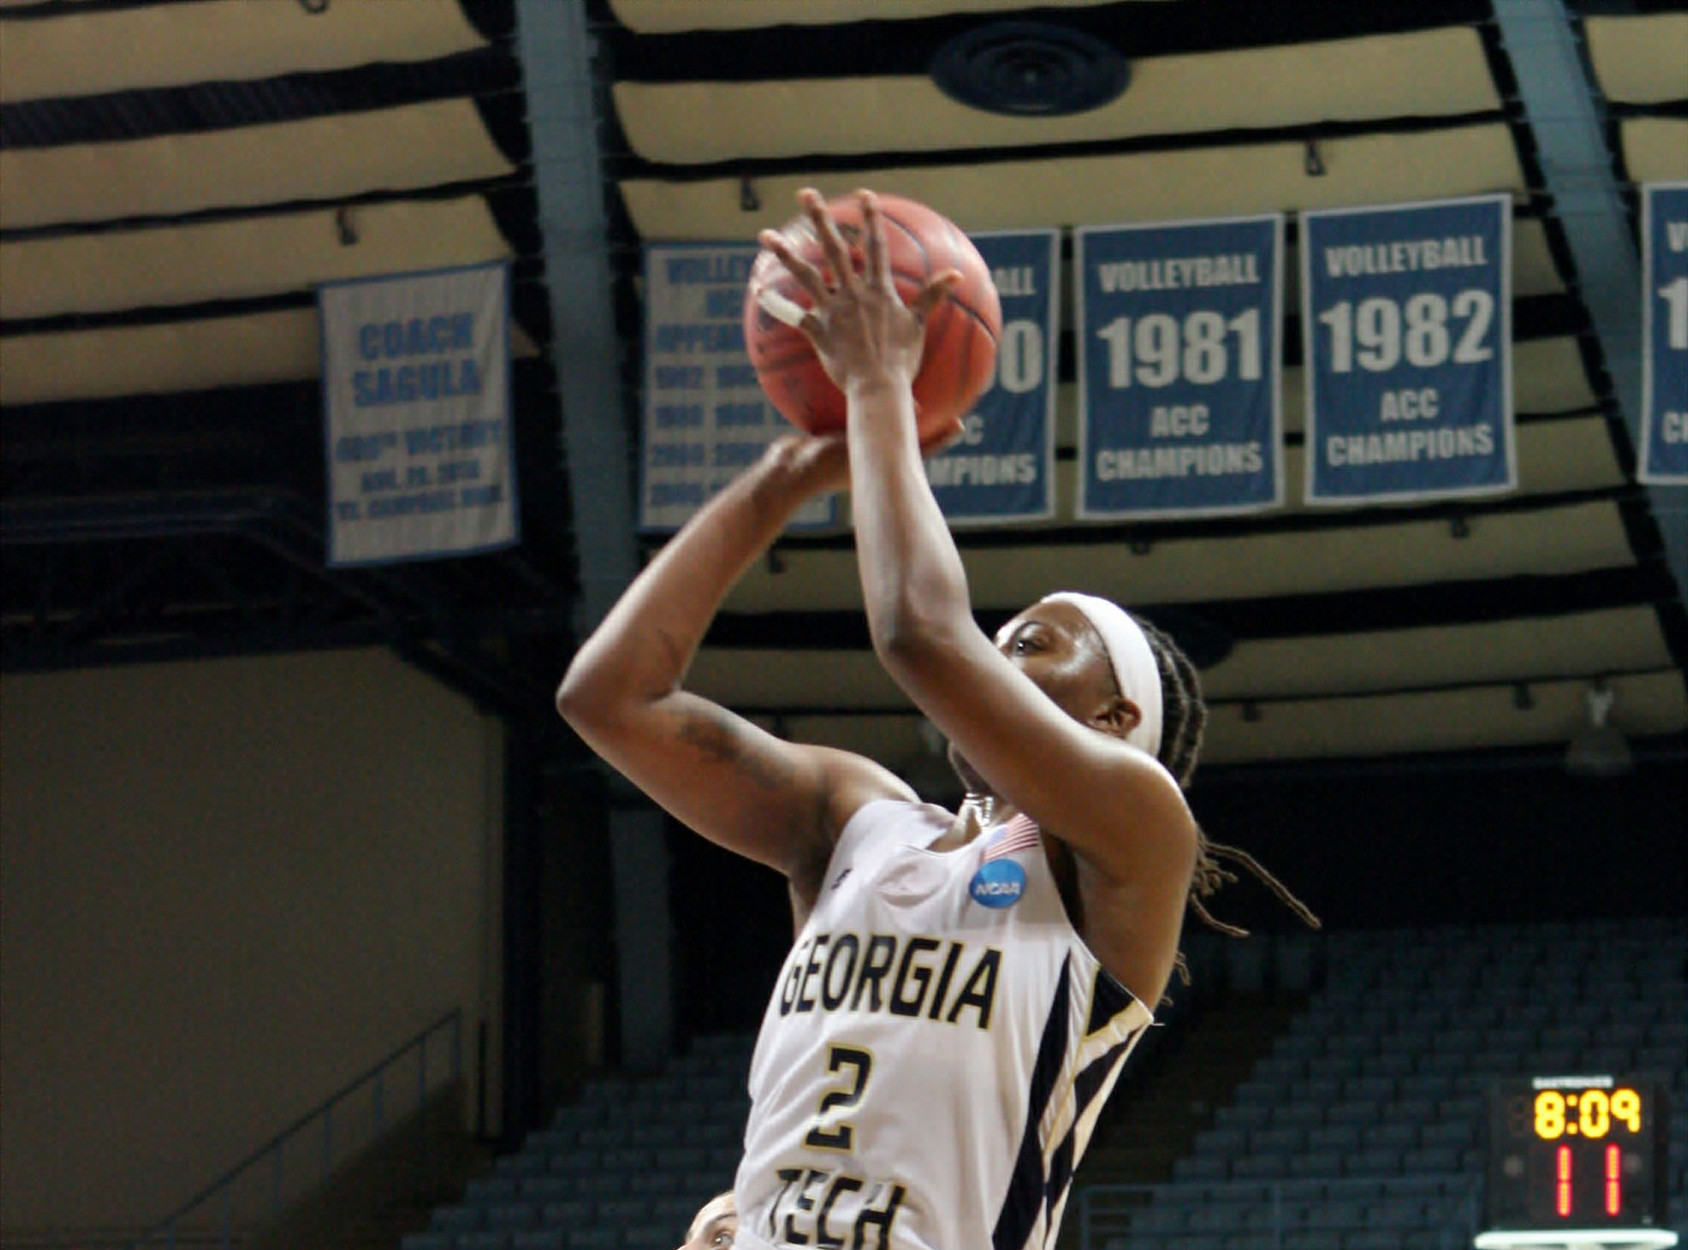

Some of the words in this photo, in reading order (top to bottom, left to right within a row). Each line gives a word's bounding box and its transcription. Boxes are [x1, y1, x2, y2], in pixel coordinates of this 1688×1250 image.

[1099, 255, 1259, 292] VOLLEYBALL
[1325, 236, 1488, 277] VOLLEYBALL
[359, 312, 474, 361] COACH
[1097, 308, 1262, 389] 1981
[1319, 289, 1494, 373] 1982
[1151, 404, 1209, 437] ACC
[1380, 387, 1439, 422] ACC
[1096, 442, 1262, 482] CHAMPIONS
[1328, 422, 1494, 466] CHAMPIONS
[925, 455, 1037, 487] MPIONS
[779, 928, 1004, 1032] GEORGIA
[804, 1042, 874, 1154] 2
[1534, 1088, 1641, 1140] 8:09
[1556, 1143, 1621, 1217] 11
